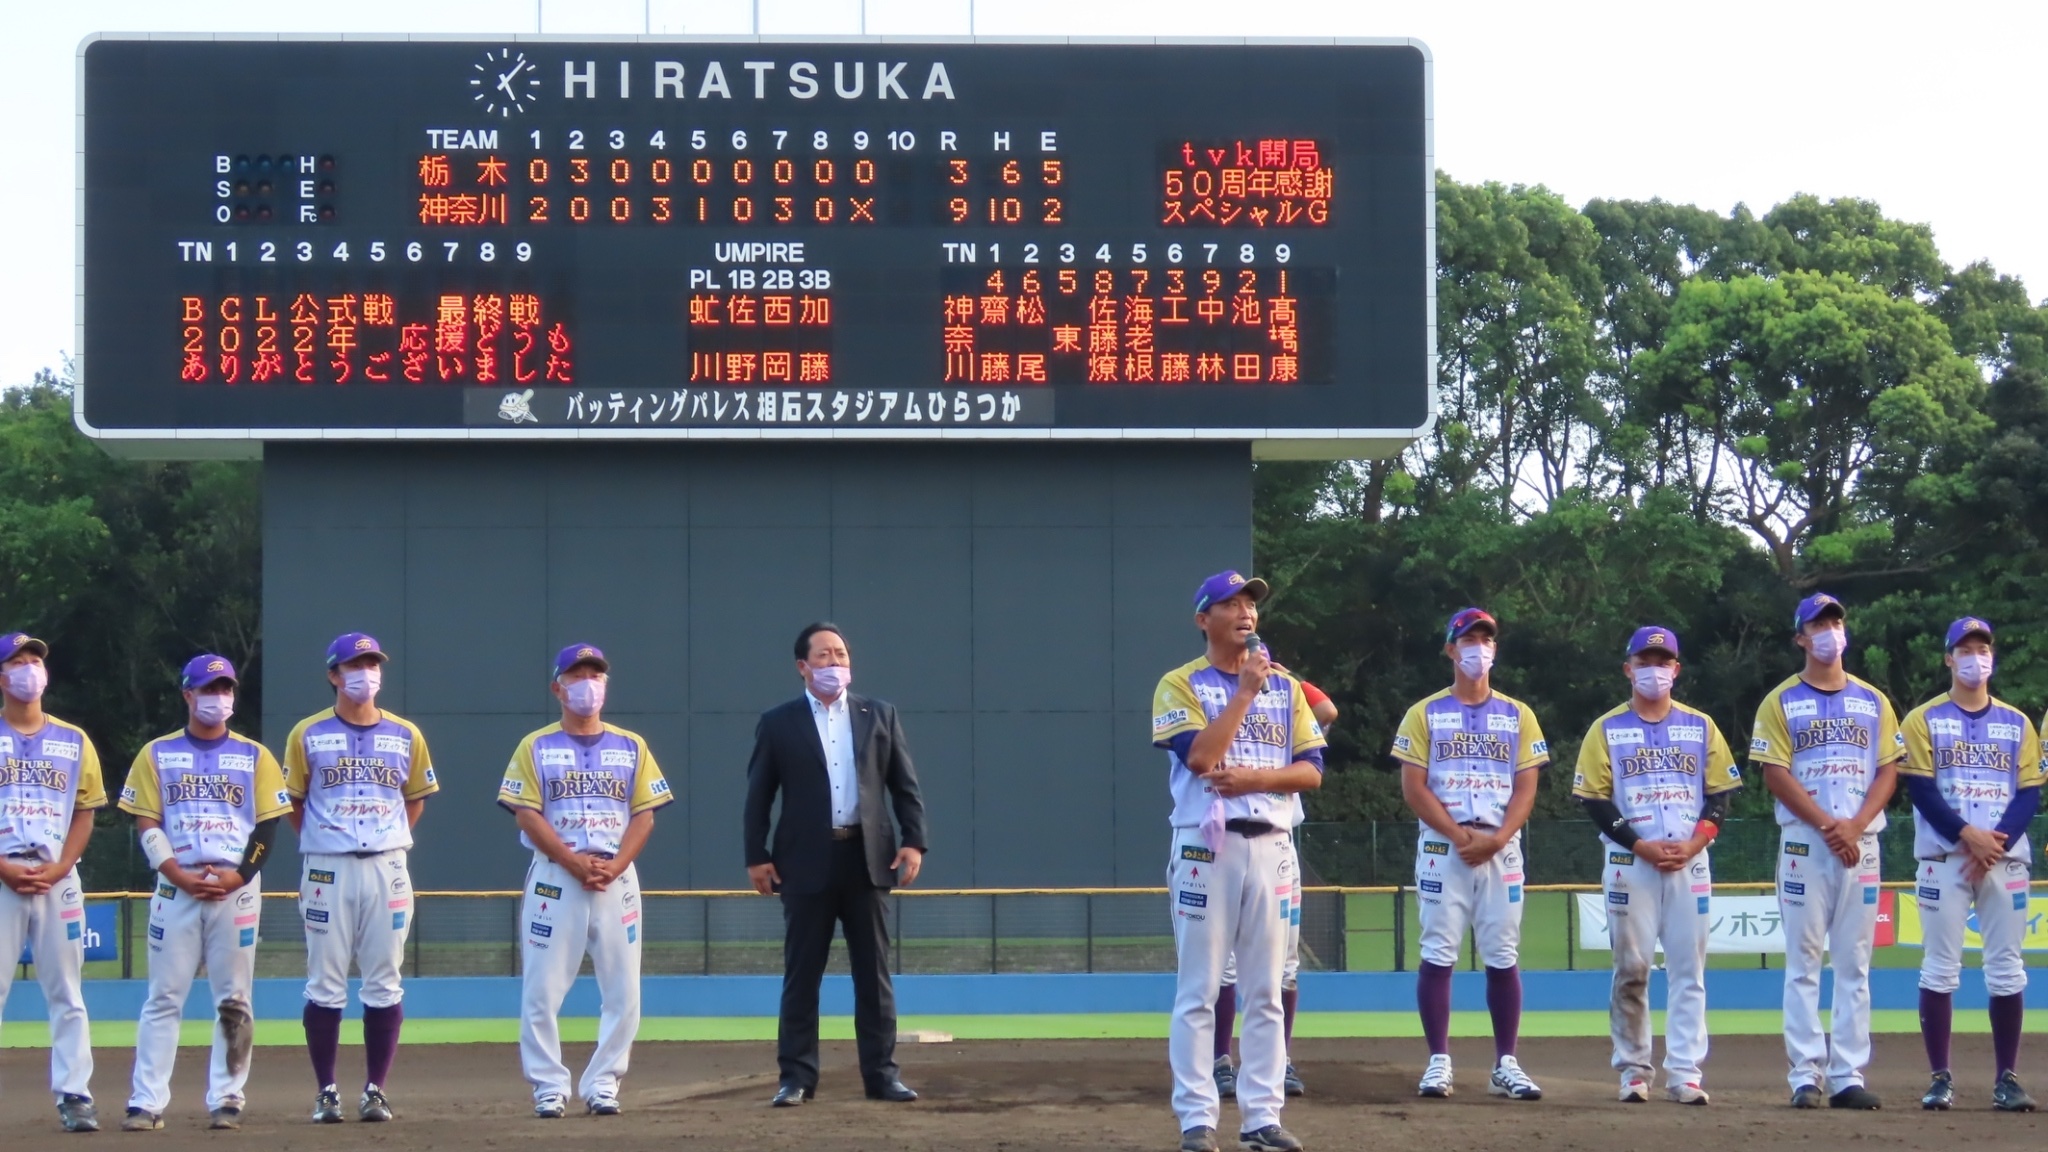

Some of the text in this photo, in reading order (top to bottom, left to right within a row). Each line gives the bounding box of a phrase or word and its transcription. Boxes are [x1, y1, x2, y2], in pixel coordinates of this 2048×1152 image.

[565, 62, 954, 99] HIRATSUKA
[427, 130, 1056, 151] TEAM 1 2 3 4 5 6 7 8 9 10 R H E
[217, 156, 230, 172] B
[301, 157, 314, 173] H
[531, 160, 547, 182] 0
[572, 160, 587, 182] 3
[612, 160, 628, 182] 0
[653, 160, 669, 182] 0
[694, 160, 710, 182] 0
[735, 160, 751, 182] 0
[776, 161, 791, 183] 0
[816, 161, 832, 183] 0
[857, 161, 873, 183] 0
[951, 161, 966, 183] 3
[1004, 161, 1019, 183] 6
[1044, 161, 1060, 183] 5
[218, 181, 230, 197] S
[301, 181, 314, 197] E
[1167, 168, 1332, 198] 50周年感謝
[420, 194, 504, 223] 神奈川
[531, 198, 547, 220] 2
[572, 198, 587, 220] 0
[612, 198, 628, 220] 0
[653, 198, 669, 220] 3
[700, 198, 704, 220] 1
[735, 198, 751, 220] 0
[776, 198, 791, 220] 3
[816, 198, 832, 220] 0
[951, 199, 966, 221] 9
[991, 199, 1020, 221] 10
[1044, 199, 1060, 221] 2
[1164, 198, 1327, 226] スペシャルG
[179, 242, 531, 261] TN 1 2 3 4 5 6 7 8 9
[716, 243, 804, 262] UMPIRE
[943, 244, 1290, 263] TN 1 2 3 4 5 6 7 8 9
[691, 270, 830, 289] PL 1B 2B 3B
[988, 271, 1285, 293] 4 6 5 8 7 3 9 2 1
[183, 294, 539, 326] BCL公式戦 最終戦
[184, 326, 357, 353] 2022年
[727, 295, 755, 380] 佐野
[764, 297, 791, 380] 西岡
[800, 295, 828, 380] 加藤
[945, 297, 973, 380] 神奈川
[1017, 297, 1045, 381] 松尾
[1054, 324, 1081, 352] 東
[1125, 297, 1153, 381] 海老根
[1161, 297, 1189, 381] 工藤
[1197, 297, 1225, 381] 中林
[1233, 297, 1260, 379] 池田
[181, 351, 574, 382] ありがとうございました
[1241, 713, 1269, 724] URE
[1809, 717, 1855, 728] FUTURE
[1235, 723, 1287, 748] EAMS
[1453, 732, 1498, 742] FUTURE
[1794, 726, 1869, 752] DREAMS
[1954, 740, 1998, 752] FUTURE
[338, 757, 385, 767] FUTURE
[1436, 740, 1510, 763] DREAMS
[1635, 745, 1681, 756] FUTURE
[1938, 748, 2011, 773] DREAMS
[181, 773, 229, 783] FUTURE
[321, 766, 401, 789] DREAMS
[565, 770, 613, 780] FUTURE
[1619, 754, 1698, 779] DREAMS
[166, 782, 245, 807] DREAMS
[548, 778, 628, 802] DREAMS
[1445, 777, 1510, 790] タックルベリー
[560, 816, 622, 829] タックルベリー
